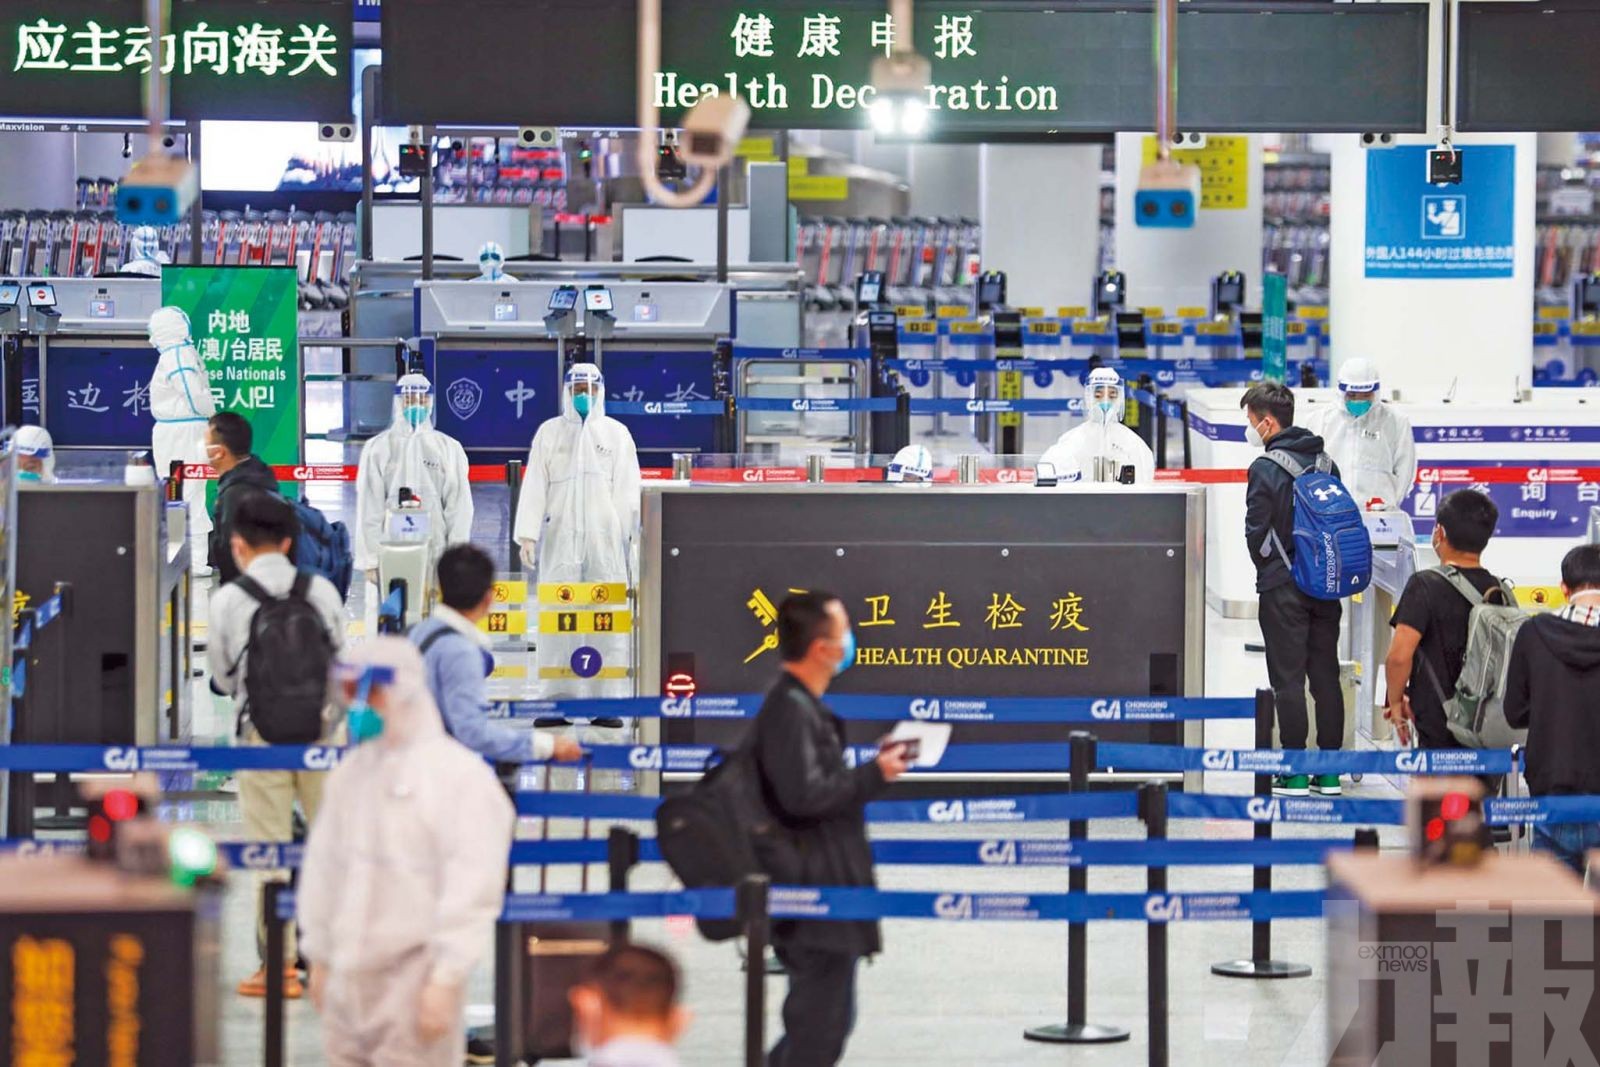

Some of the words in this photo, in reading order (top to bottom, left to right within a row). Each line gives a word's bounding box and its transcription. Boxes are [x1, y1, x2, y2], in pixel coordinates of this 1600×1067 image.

[14, 19, 338, 76] 应主动向海关
[731, 13, 977, 58] 健康申报
[653, 73, 788, 110] Health
[811, 73, 1058, 111] Decration
[208, 309, 250, 334] 内地
[196, 337, 283, 361] /澳/台居民
[226, 366, 286, 380] Nationals
[505, 380, 536, 420] 中
[1511, 507, 1557, 519] Enquiry
[1322, 531, 1336, 593] ARMOUR
[858, 591, 1090, 632] 卫生检疫
[581, 654, 592, 670] 7
[856, 648, 942, 666] HEALTH
[947, 647, 1090, 669] QUARANTINE
